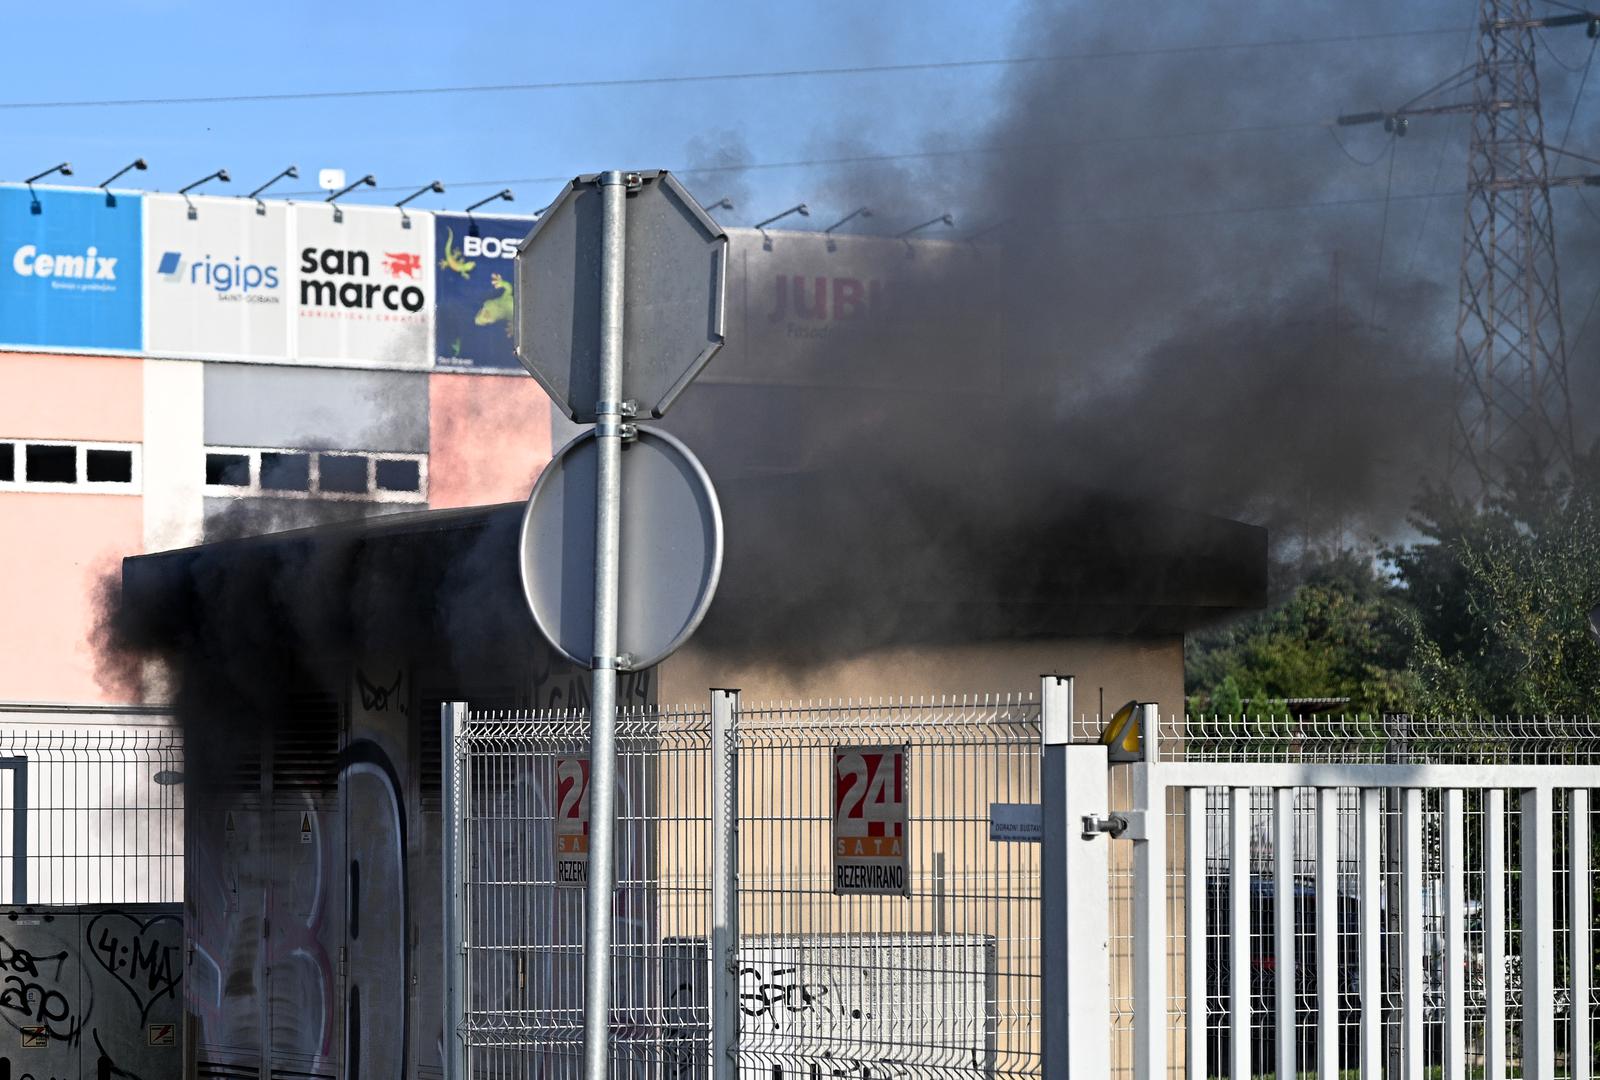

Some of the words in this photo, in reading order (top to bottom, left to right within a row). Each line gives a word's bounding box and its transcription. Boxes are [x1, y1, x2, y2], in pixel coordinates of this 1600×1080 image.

[464, 236, 525, 259] BOS
[13, 244, 118, 280] Cemix
[191, 254, 279, 292] rigips
[301, 247, 369, 276] san
[300, 280, 425, 313] marco
[838, 753, 902, 836] 24
[559, 838, 587, 850] SA
[838, 839, 901, 855] SATA
[559, 860, 588, 881] REZERV
[837, 864, 903, 889] REZERVIRANO
